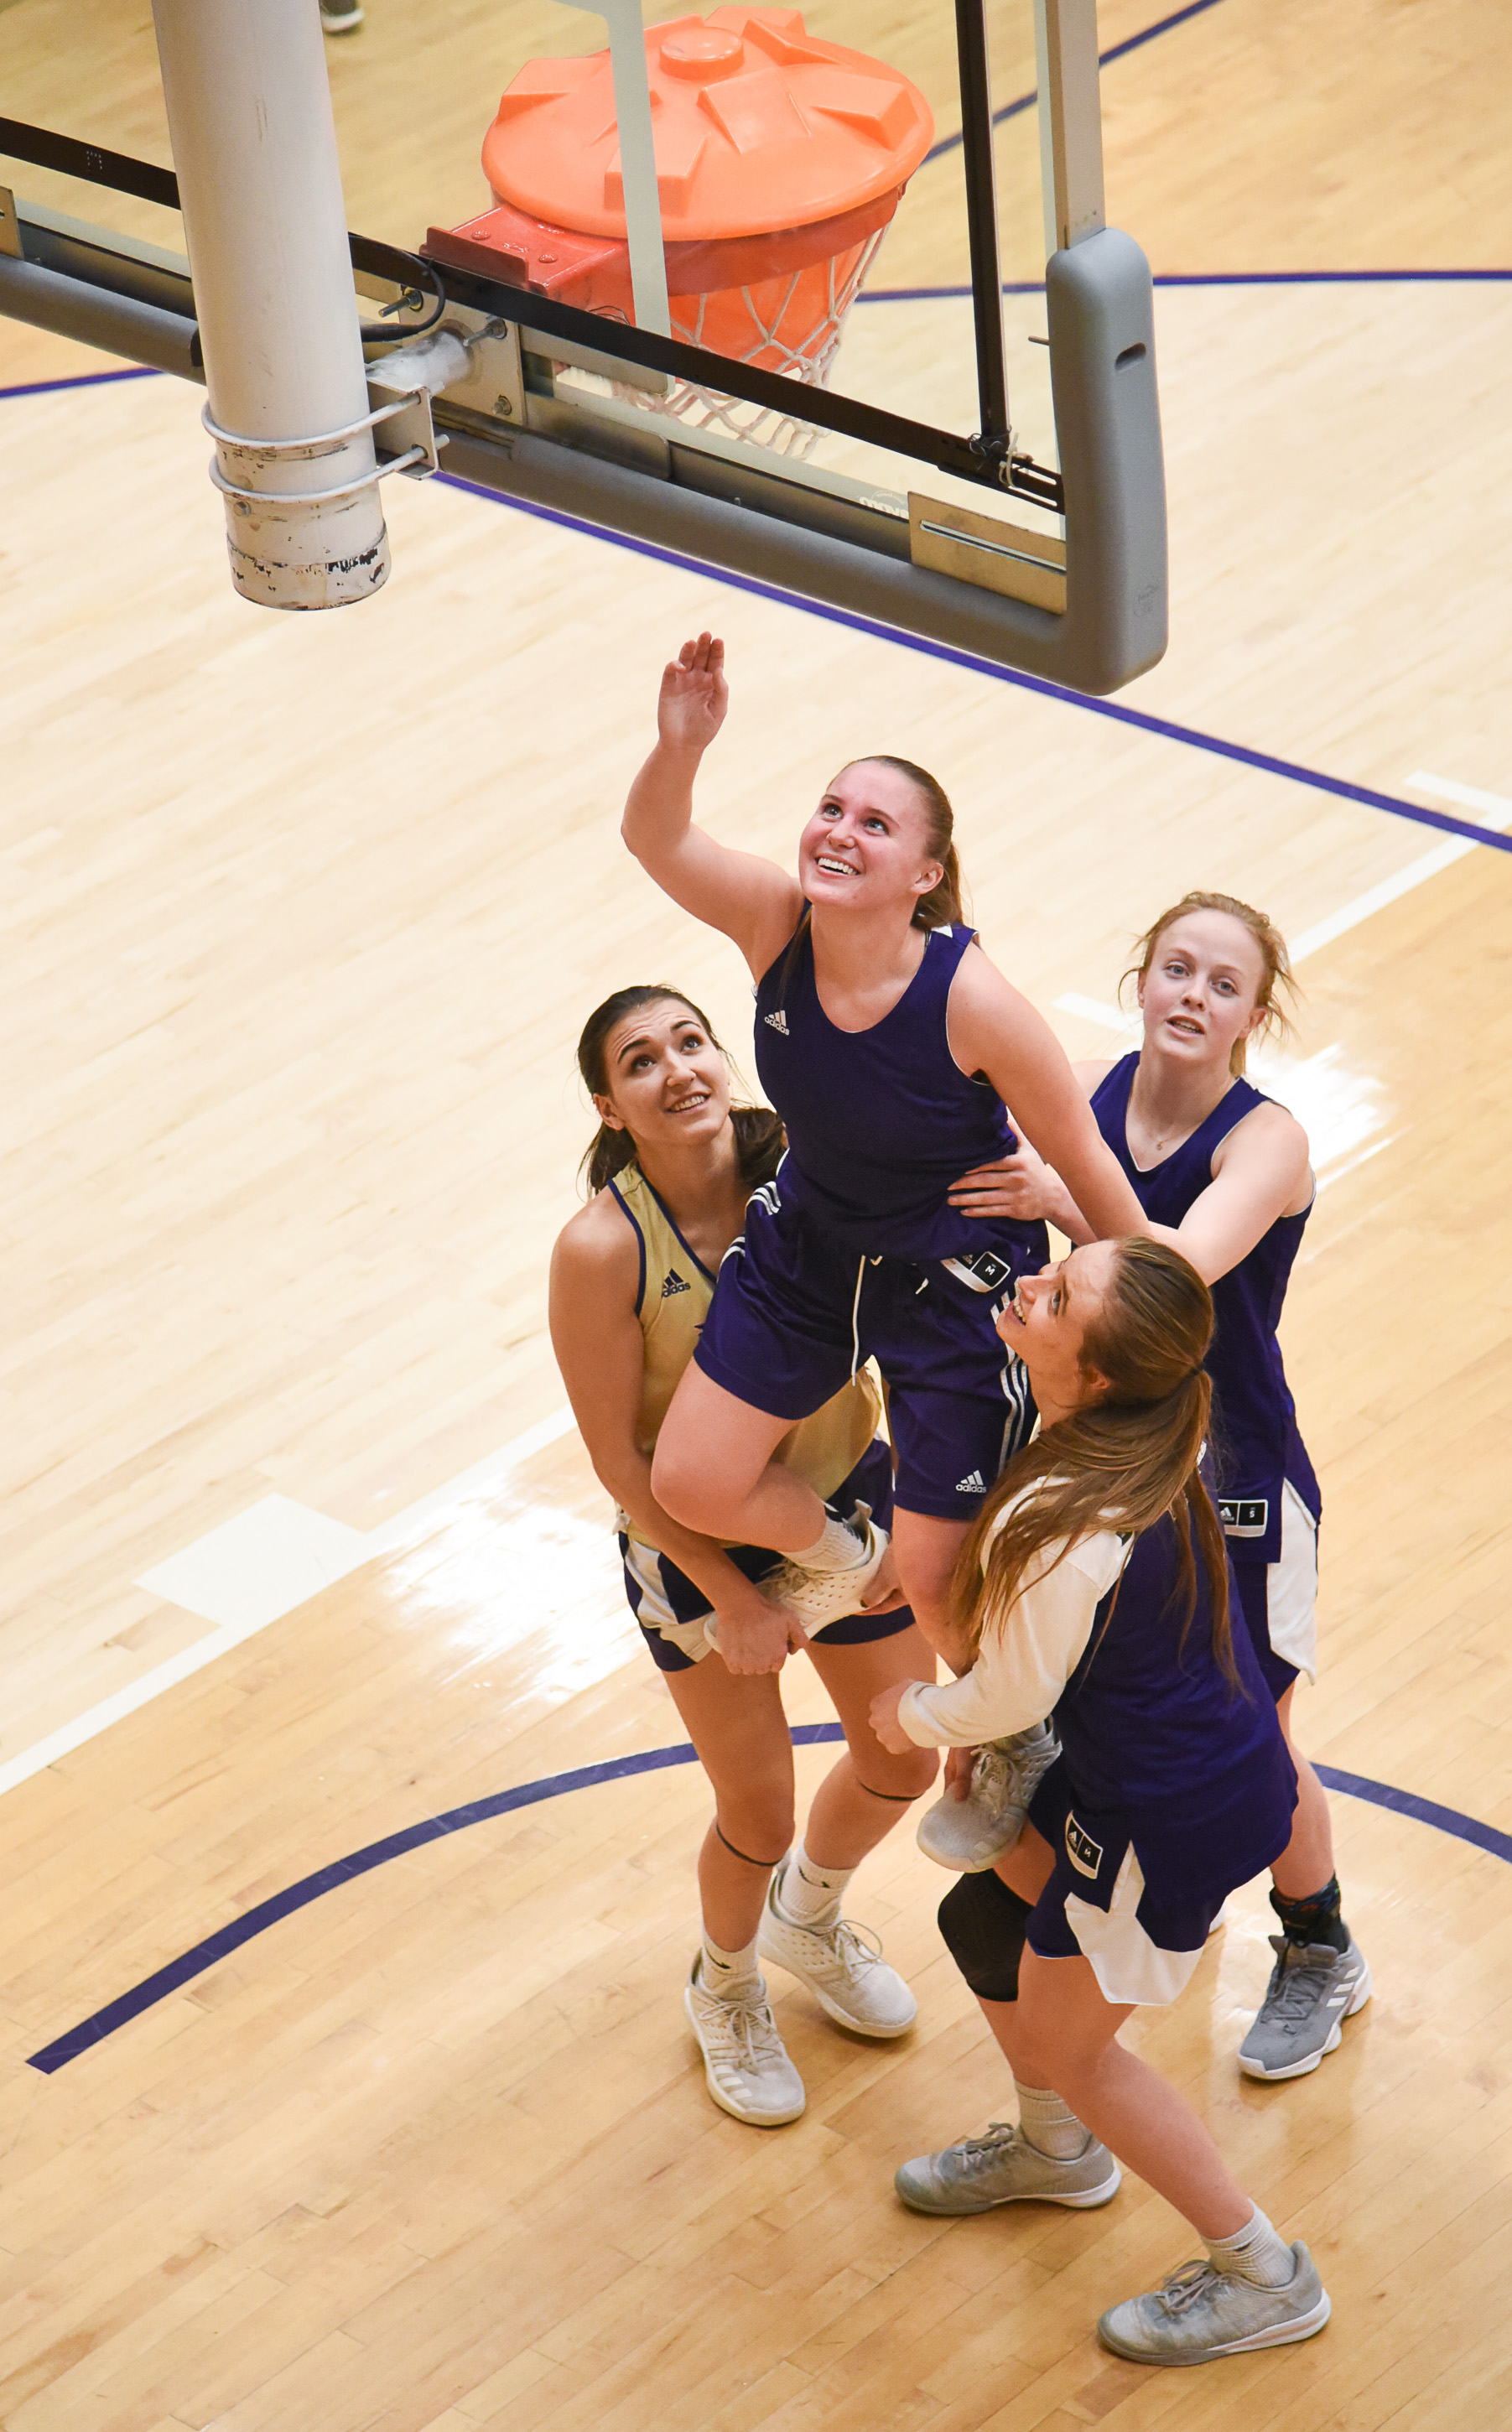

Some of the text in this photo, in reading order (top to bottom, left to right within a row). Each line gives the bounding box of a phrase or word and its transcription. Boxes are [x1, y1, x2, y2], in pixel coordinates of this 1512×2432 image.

[764, 1016, 790, 1036] adidas
[985, 1265, 995, 1276] M
[955, 1484, 987, 1493] adidas
